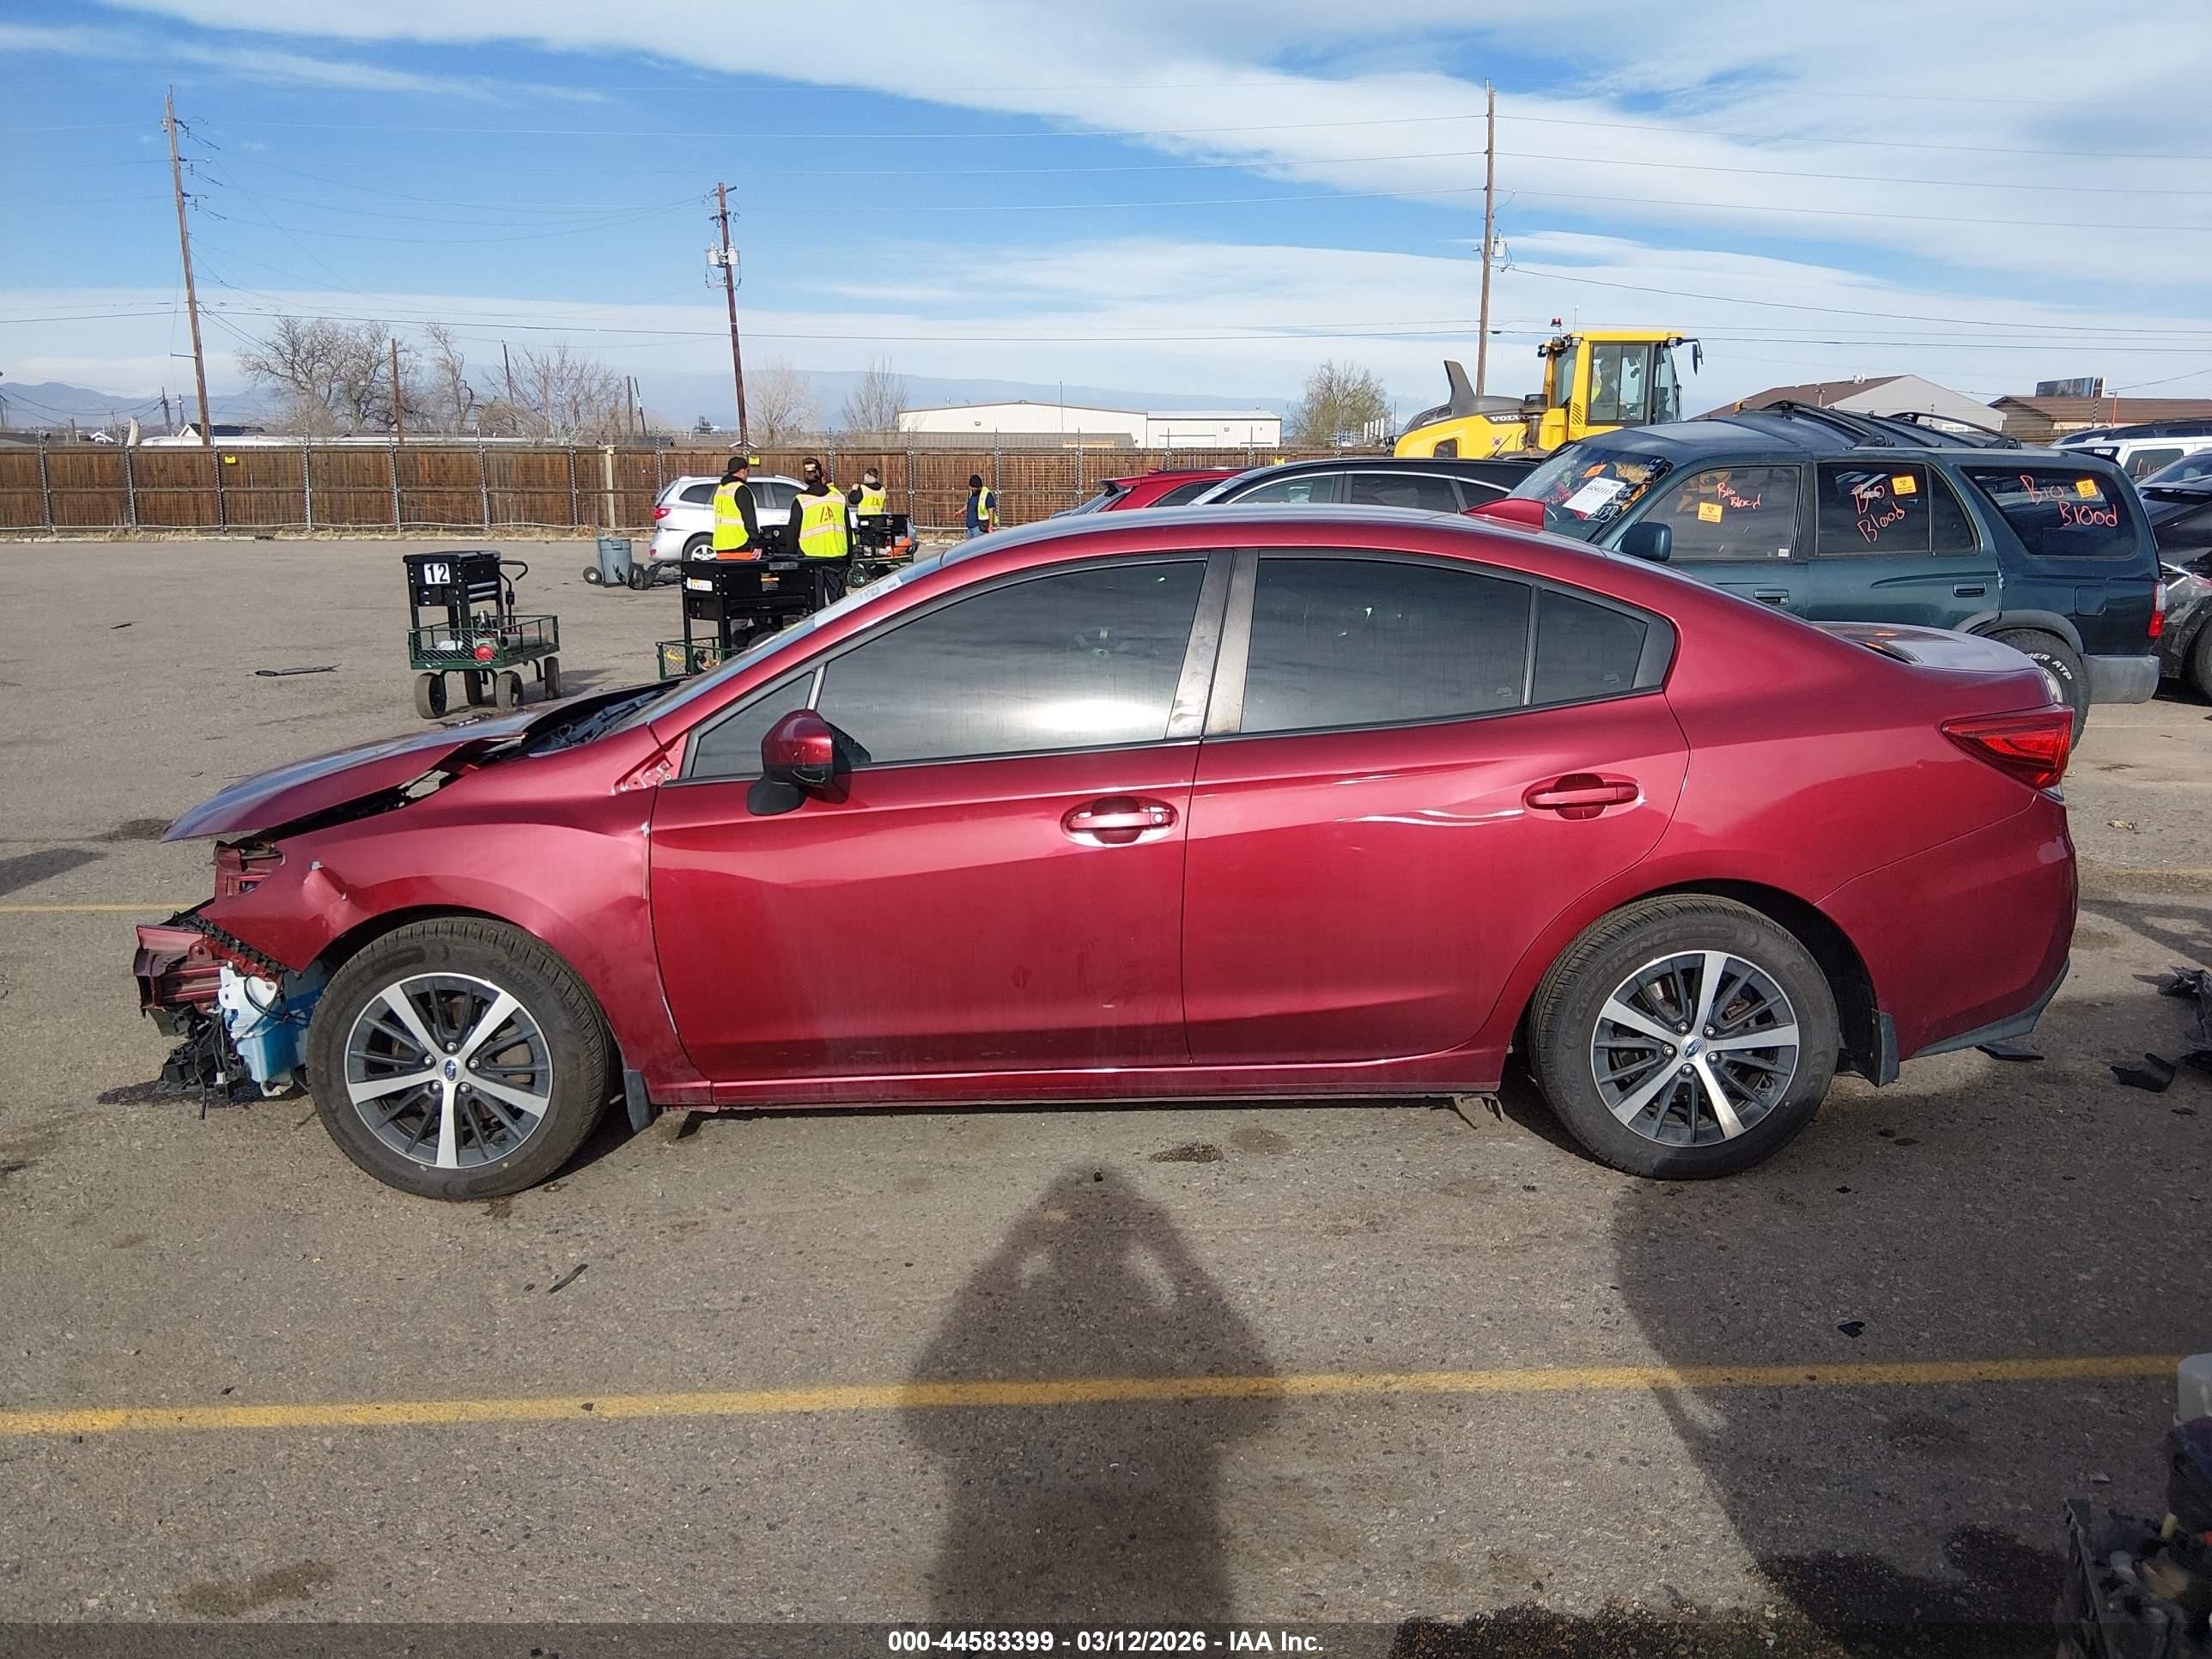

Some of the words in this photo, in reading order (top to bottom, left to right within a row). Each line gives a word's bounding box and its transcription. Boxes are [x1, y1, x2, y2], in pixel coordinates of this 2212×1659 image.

[1717, 483, 1735, 501] Bio
[1857, 501, 1905, 543] Blood
[428, 563, 448, 582] 12
[2051, 660, 2072, 680] ATP
